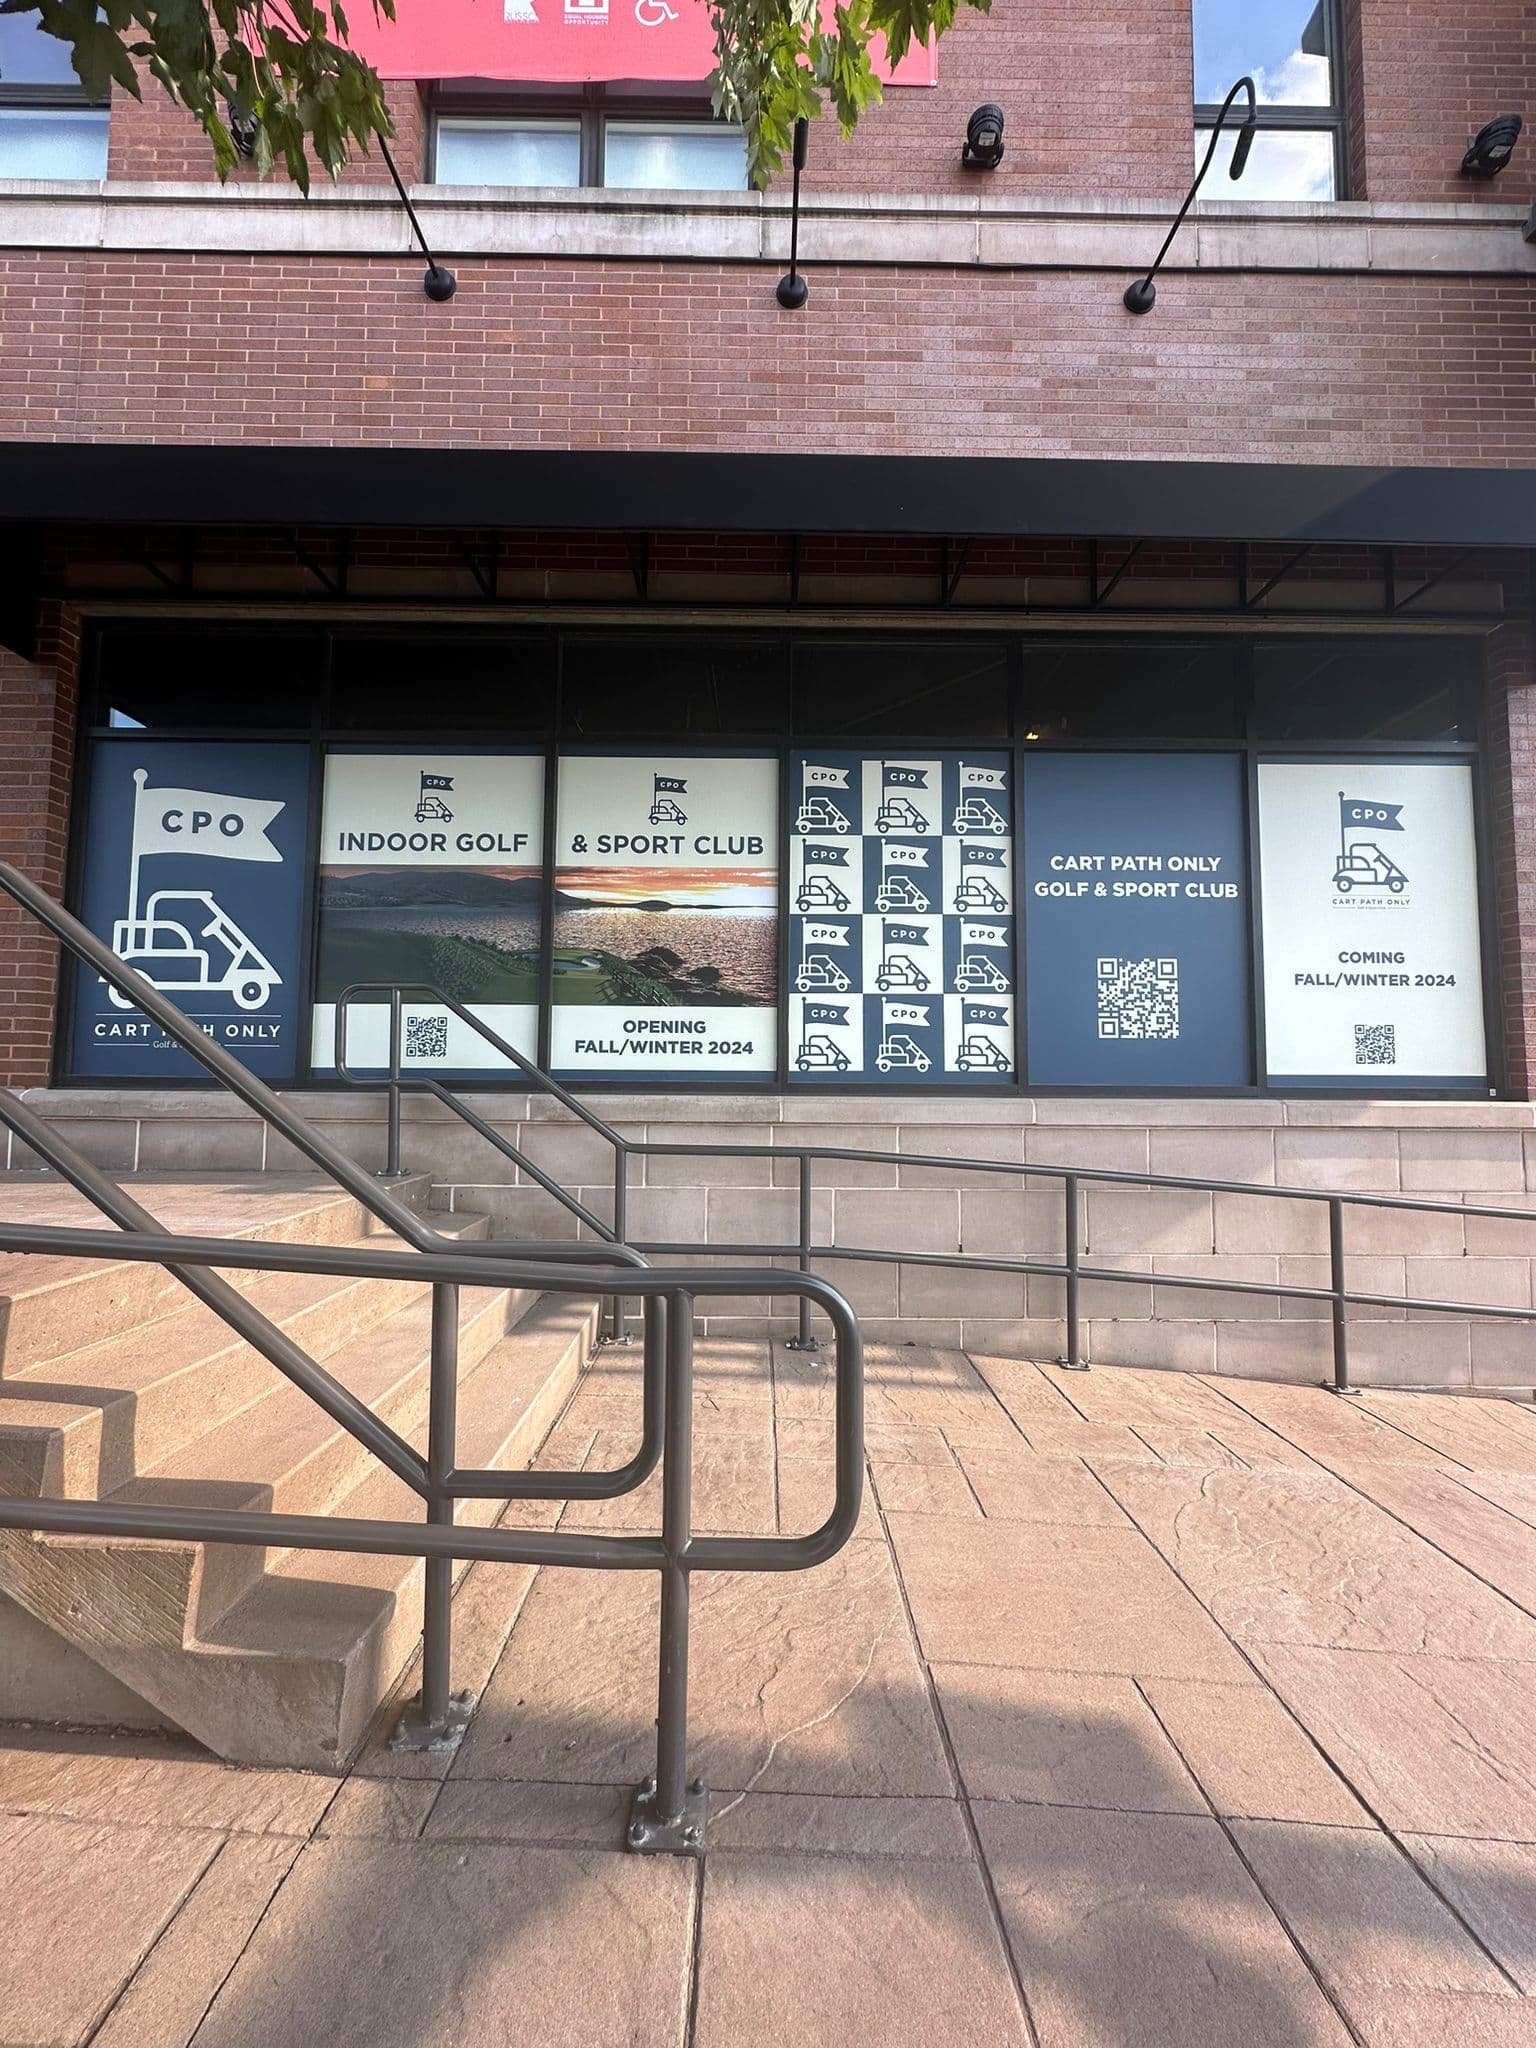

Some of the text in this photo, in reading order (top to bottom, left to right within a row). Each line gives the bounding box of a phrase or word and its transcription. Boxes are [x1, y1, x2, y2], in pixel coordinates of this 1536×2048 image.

[426, 778, 447, 787] CPO
[811, 772, 838, 782] CPO
[890, 772, 916, 783] CPO
[967, 773, 994, 783] CPO
[659, 781, 681, 790] CPO
[1351, 808, 1388, 822] CPO
[161, 809, 244, 837] CPO
[339, 832, 529, 853] INDOOR GOLF
[571, 834, 764, 855] & SPORT CLUB
[811, 850, 838, 860] CPO
[890, 850, 917, 860] CPO
[968, 851, 995, 861] CPO
[1050, 855, 1222, 872] CART PATH ONLY
[1034, 881, 1238, 898] GOLF & SPORT CLUB
[1386, 898, 1410, 906] ONLY
[811, 929, 838, 939] CPO
[890, 929, 917, 940] CPO
[969, 930, 996, 940] CPO
[1338, 951, 1405, 964] COMING
[1294, 972, 1457, 988] FALL/WINTER 2024
[811, 1009, 838, 1019] CPO
[891, 1009, 918, 1019] CPO
[970, 1009, 997, 1020] CPO
[94, 1023, 151, 1037] CART
[225, 1024, 281, 1038] ONLY
[622, 1019, 706, 1034] OPENING
[152, 1040, 171, 1049] Golf
[574, 1038, 754, 1056] FALL/WINTER 2024
